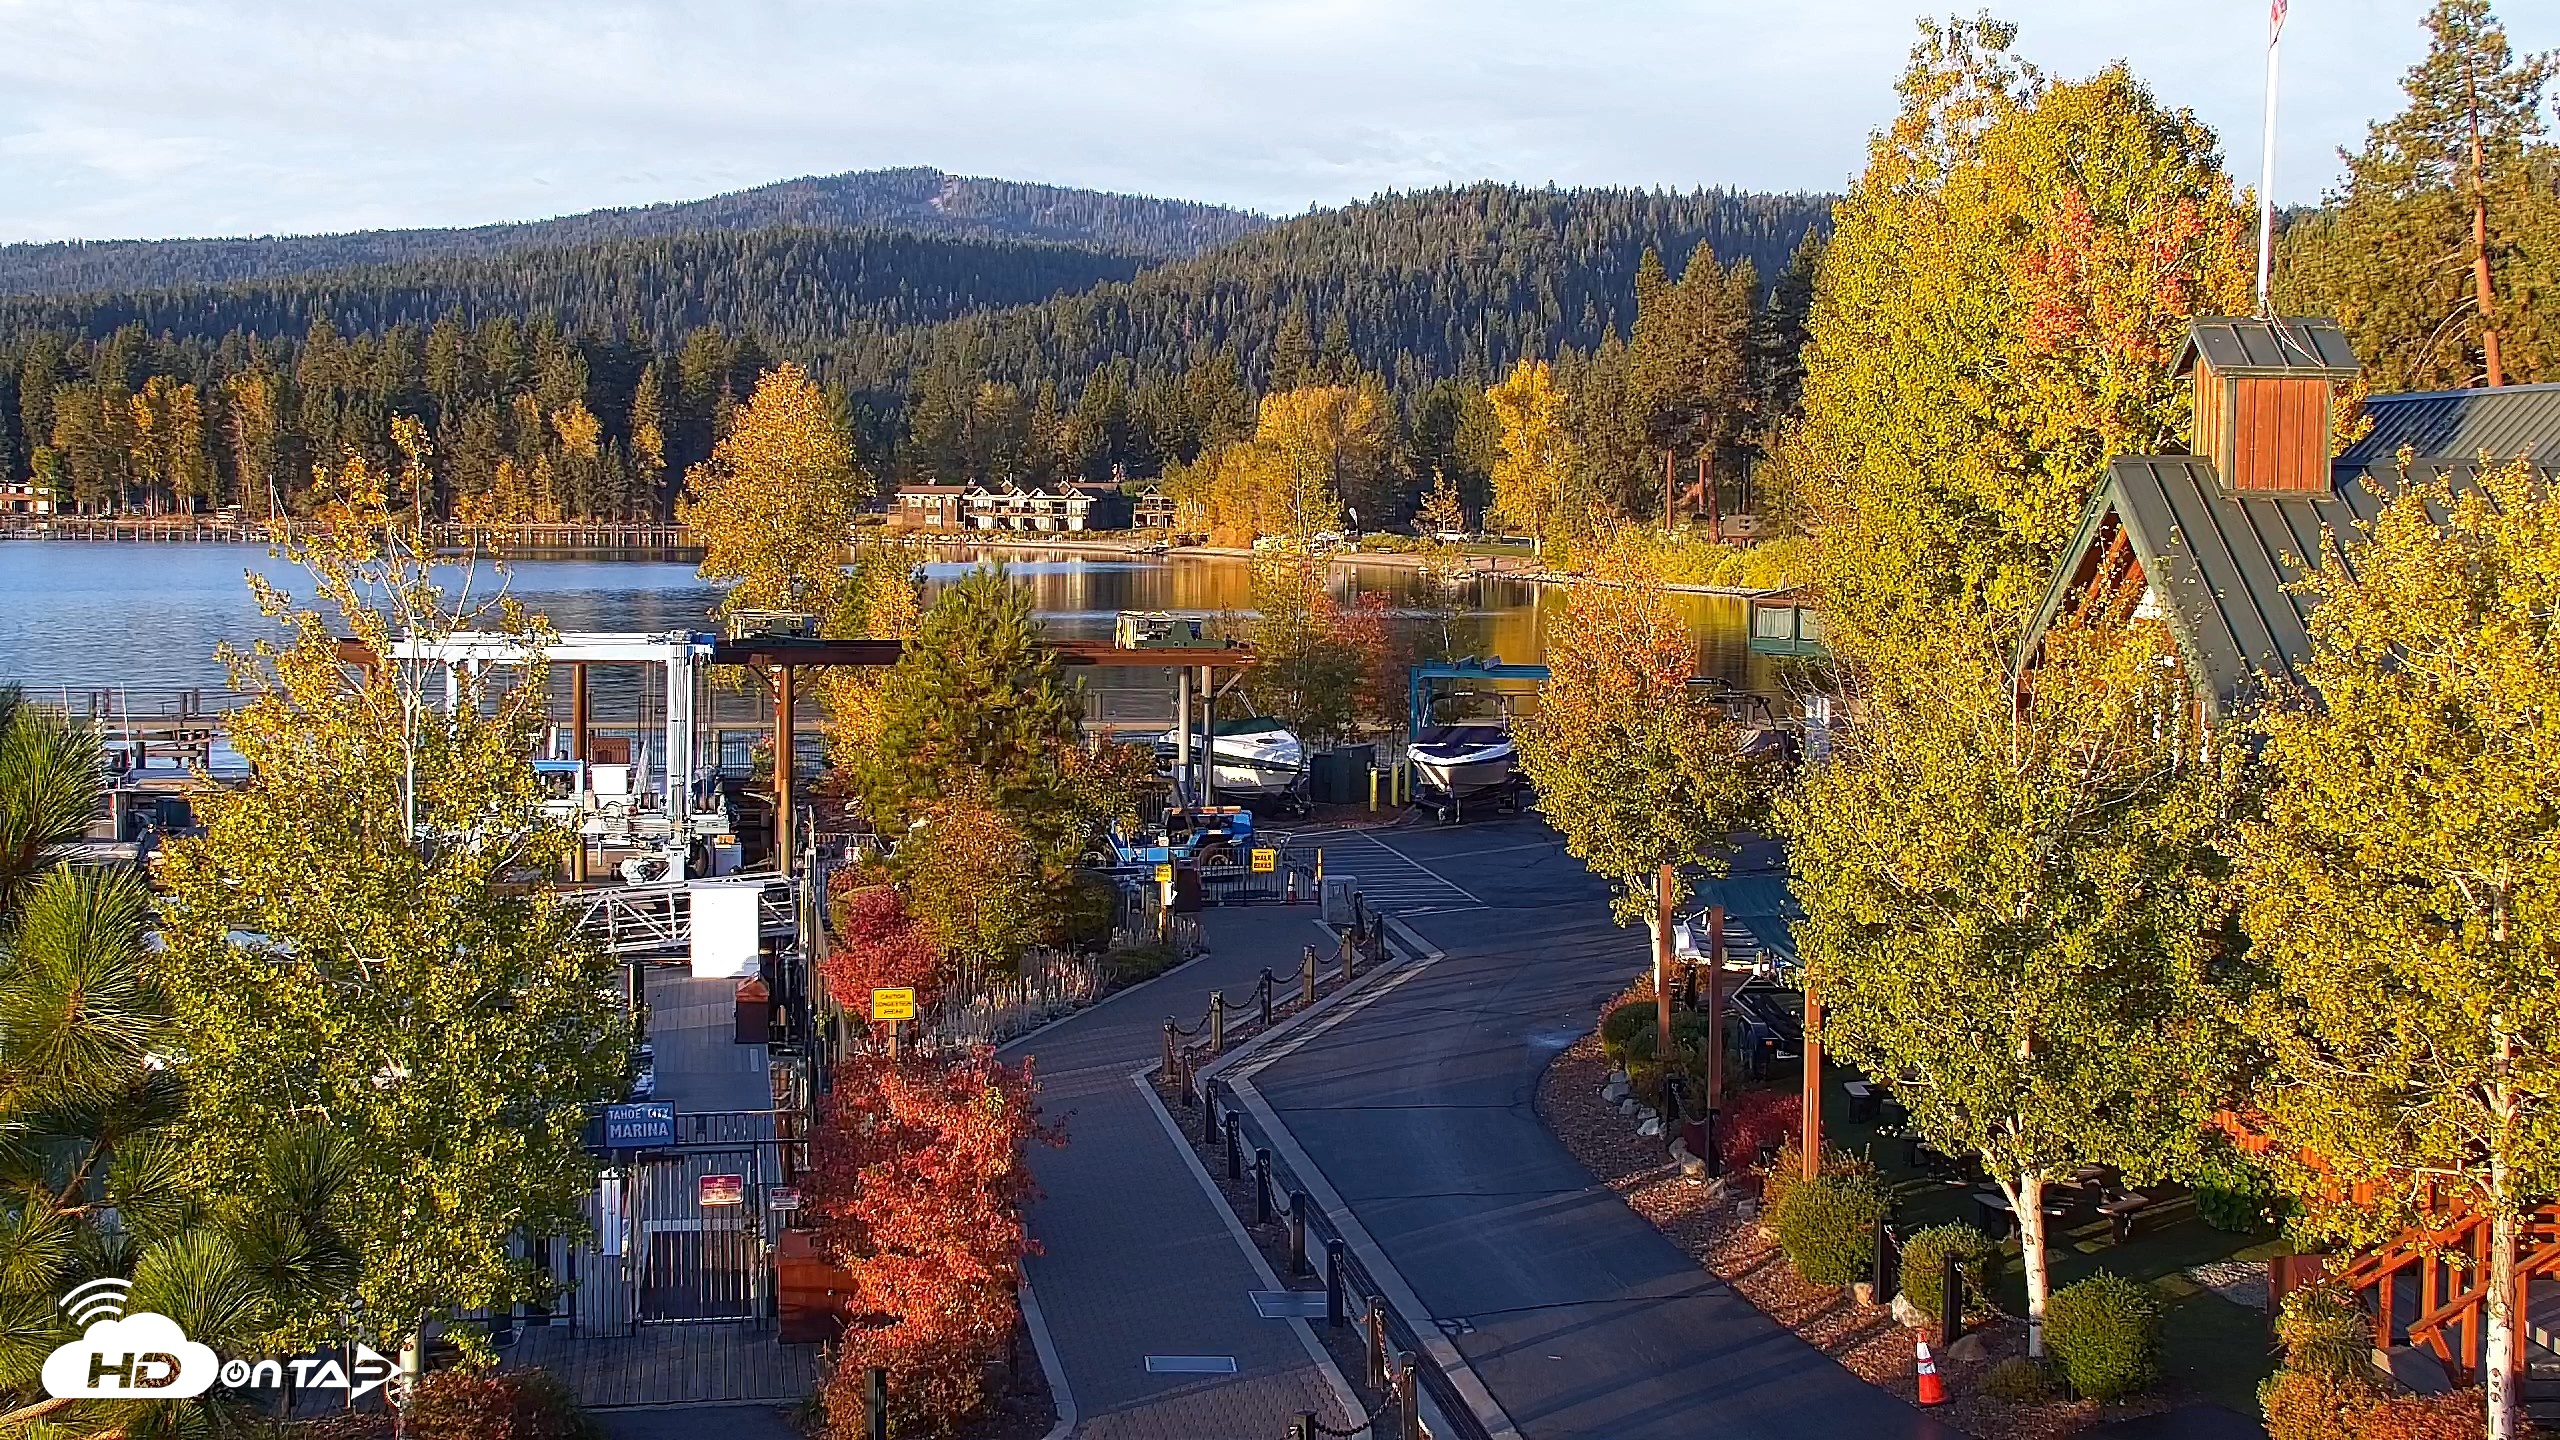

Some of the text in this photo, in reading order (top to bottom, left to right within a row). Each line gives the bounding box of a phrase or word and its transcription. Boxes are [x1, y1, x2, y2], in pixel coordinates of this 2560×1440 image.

[608, 1107, 670, 1120] TAHOE CITY
[609, 1122, 669, 1139] MARINA
